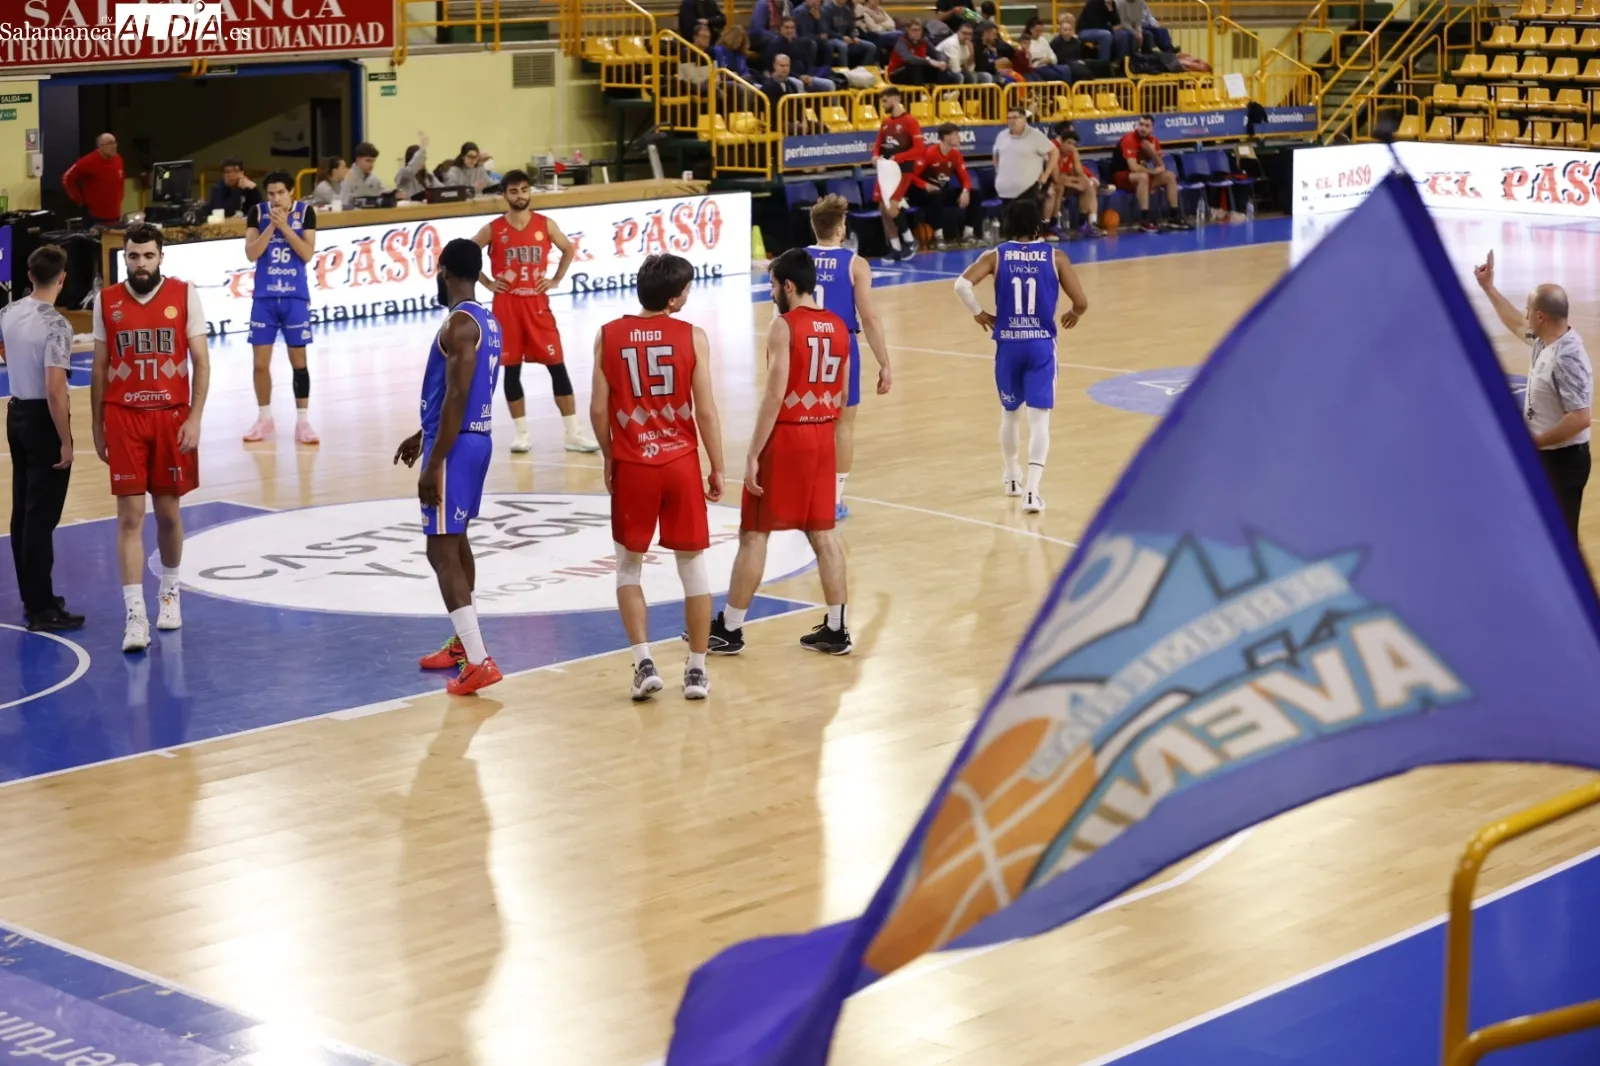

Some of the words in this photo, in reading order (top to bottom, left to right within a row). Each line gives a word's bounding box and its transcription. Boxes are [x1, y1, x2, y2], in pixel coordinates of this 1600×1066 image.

[24, 0, 346, 29] SALANCA
[236, 22, 385, 51] HUMANIDAD
[1095, 121, 1139, 135] SALAMANC
[1165, 116, 1198, 128] CASTILLA
[924, 130, 976, 145] SALNCA
[1338, 164, 1372, 188] PASO
[612, 197, 723, 257] PASO
[271, 247, 291, 263] 96
[313, 222, 443, 291] PASO
[521, 266, 529, 282] 5
[571, 263, 723, 294] Restante
[1011, 276, 1037, 315] 11
[205, 319, 232, 337] ar
[308, 291, 443, 324] staurante
[115, 327, 176, 359] PBB
[630, 328, 662, 343] IÑIGO
[1000, 329, 1051, 340] SALAMANCA
[134, 358, 158, 380] 77
[621, 345, 675, 398] 15
[807, 336, 841, 383] 16
